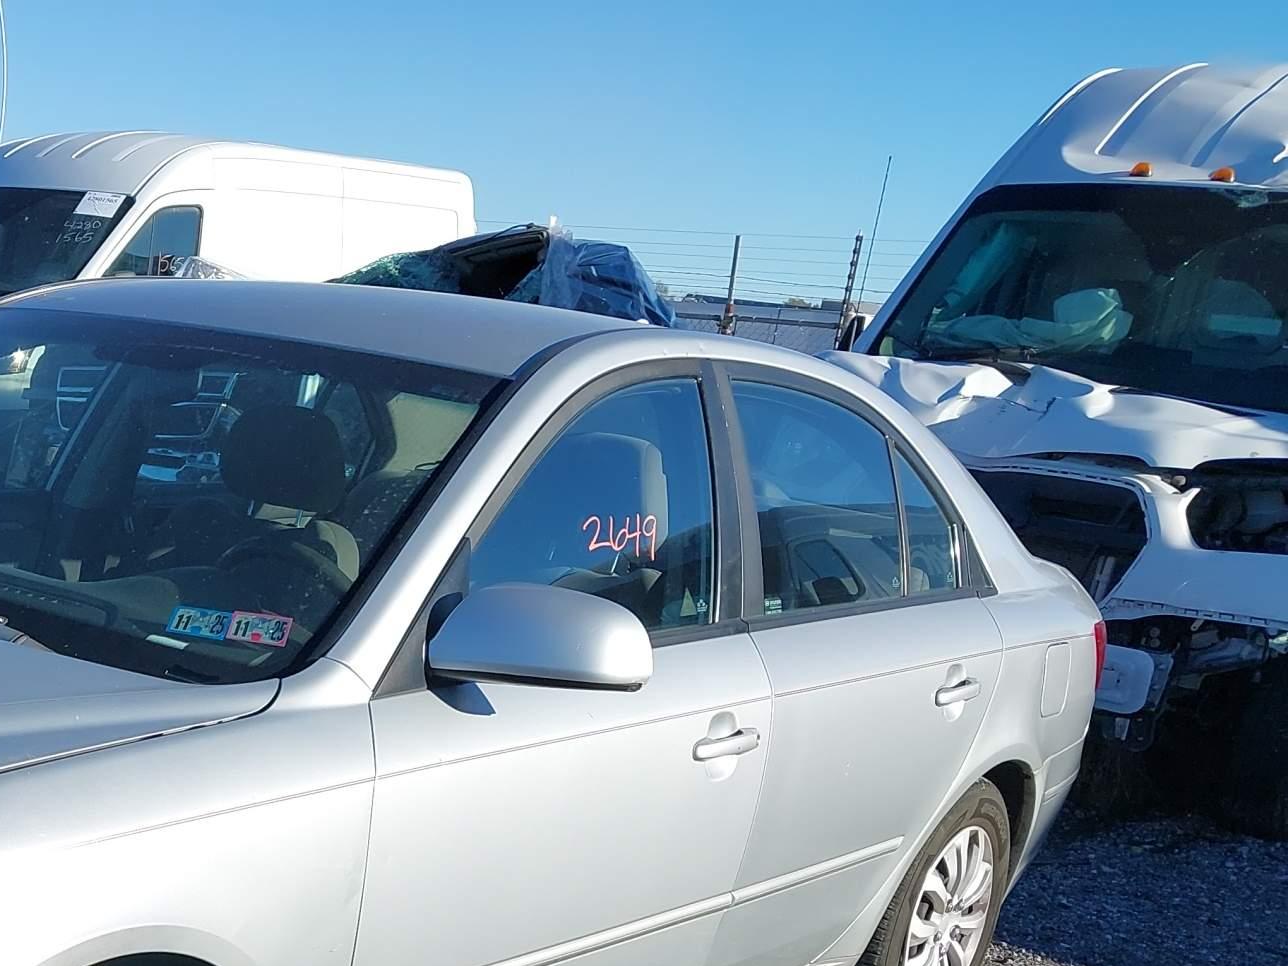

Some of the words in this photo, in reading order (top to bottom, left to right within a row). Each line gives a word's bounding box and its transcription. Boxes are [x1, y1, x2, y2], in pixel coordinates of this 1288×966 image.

[63, 220, 102, 230] 4280
[55, 232, 94, 243] 1565
[582, 513, 657, 561] 2649
